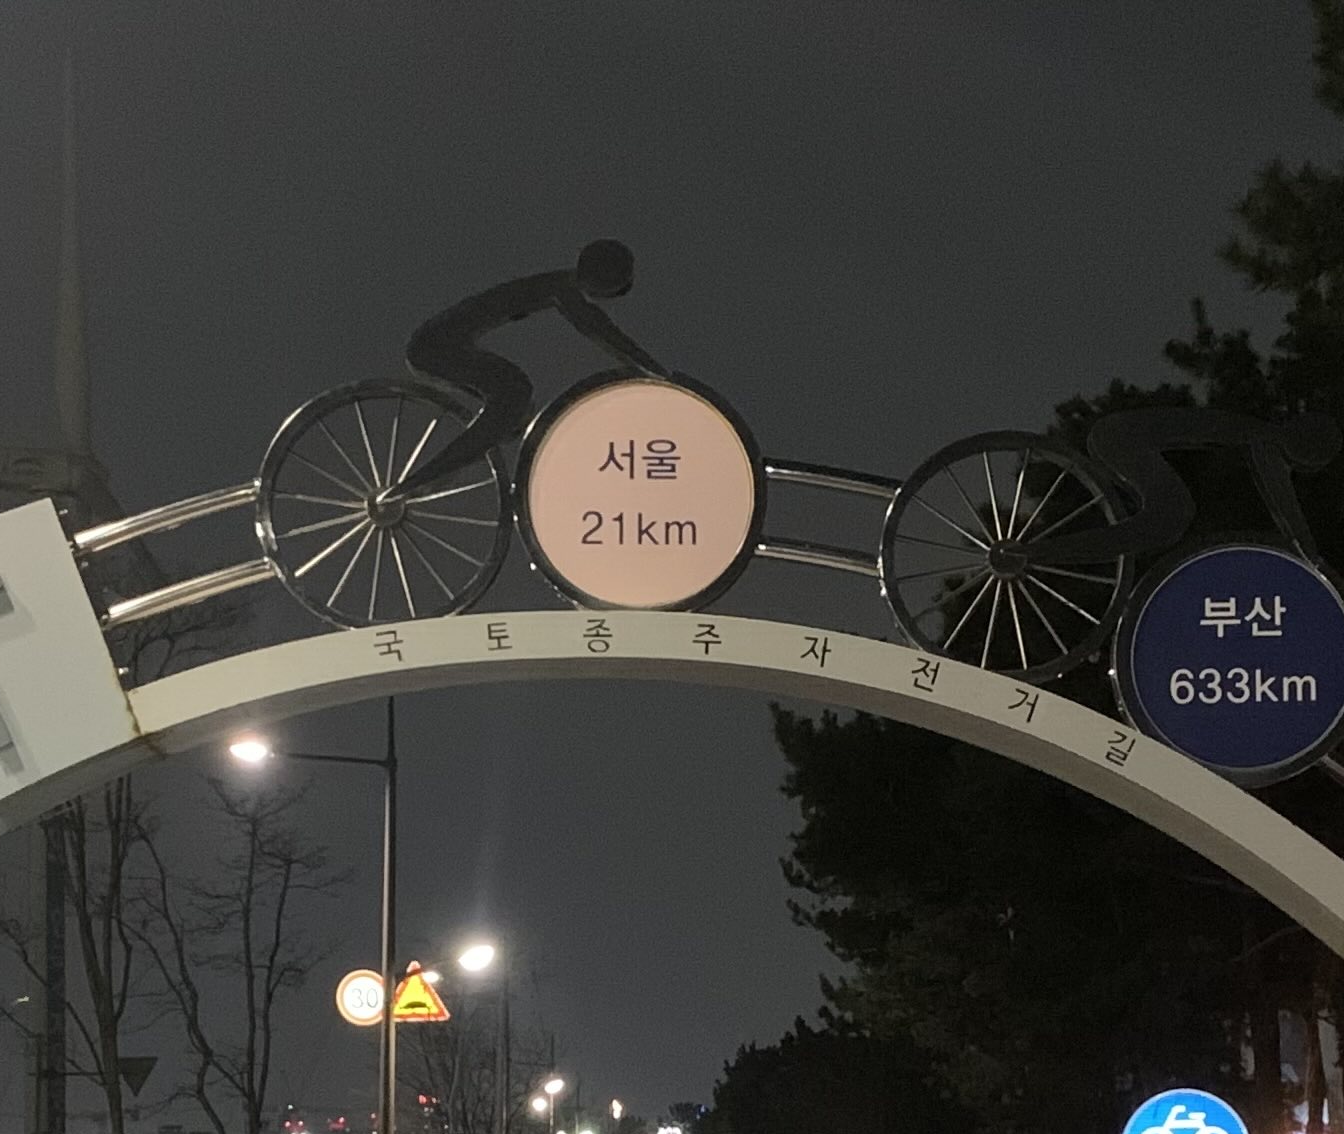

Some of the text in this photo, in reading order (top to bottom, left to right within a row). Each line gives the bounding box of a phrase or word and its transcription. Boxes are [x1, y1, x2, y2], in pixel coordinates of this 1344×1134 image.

[599, 440, 681, 480] 서울
[581, 510, 697, 546] 21km
[1199, 595, 1287, 639] 부산
[1169, 667, 1318, 706] 633km
[353, 988, 379, 1009] 30
